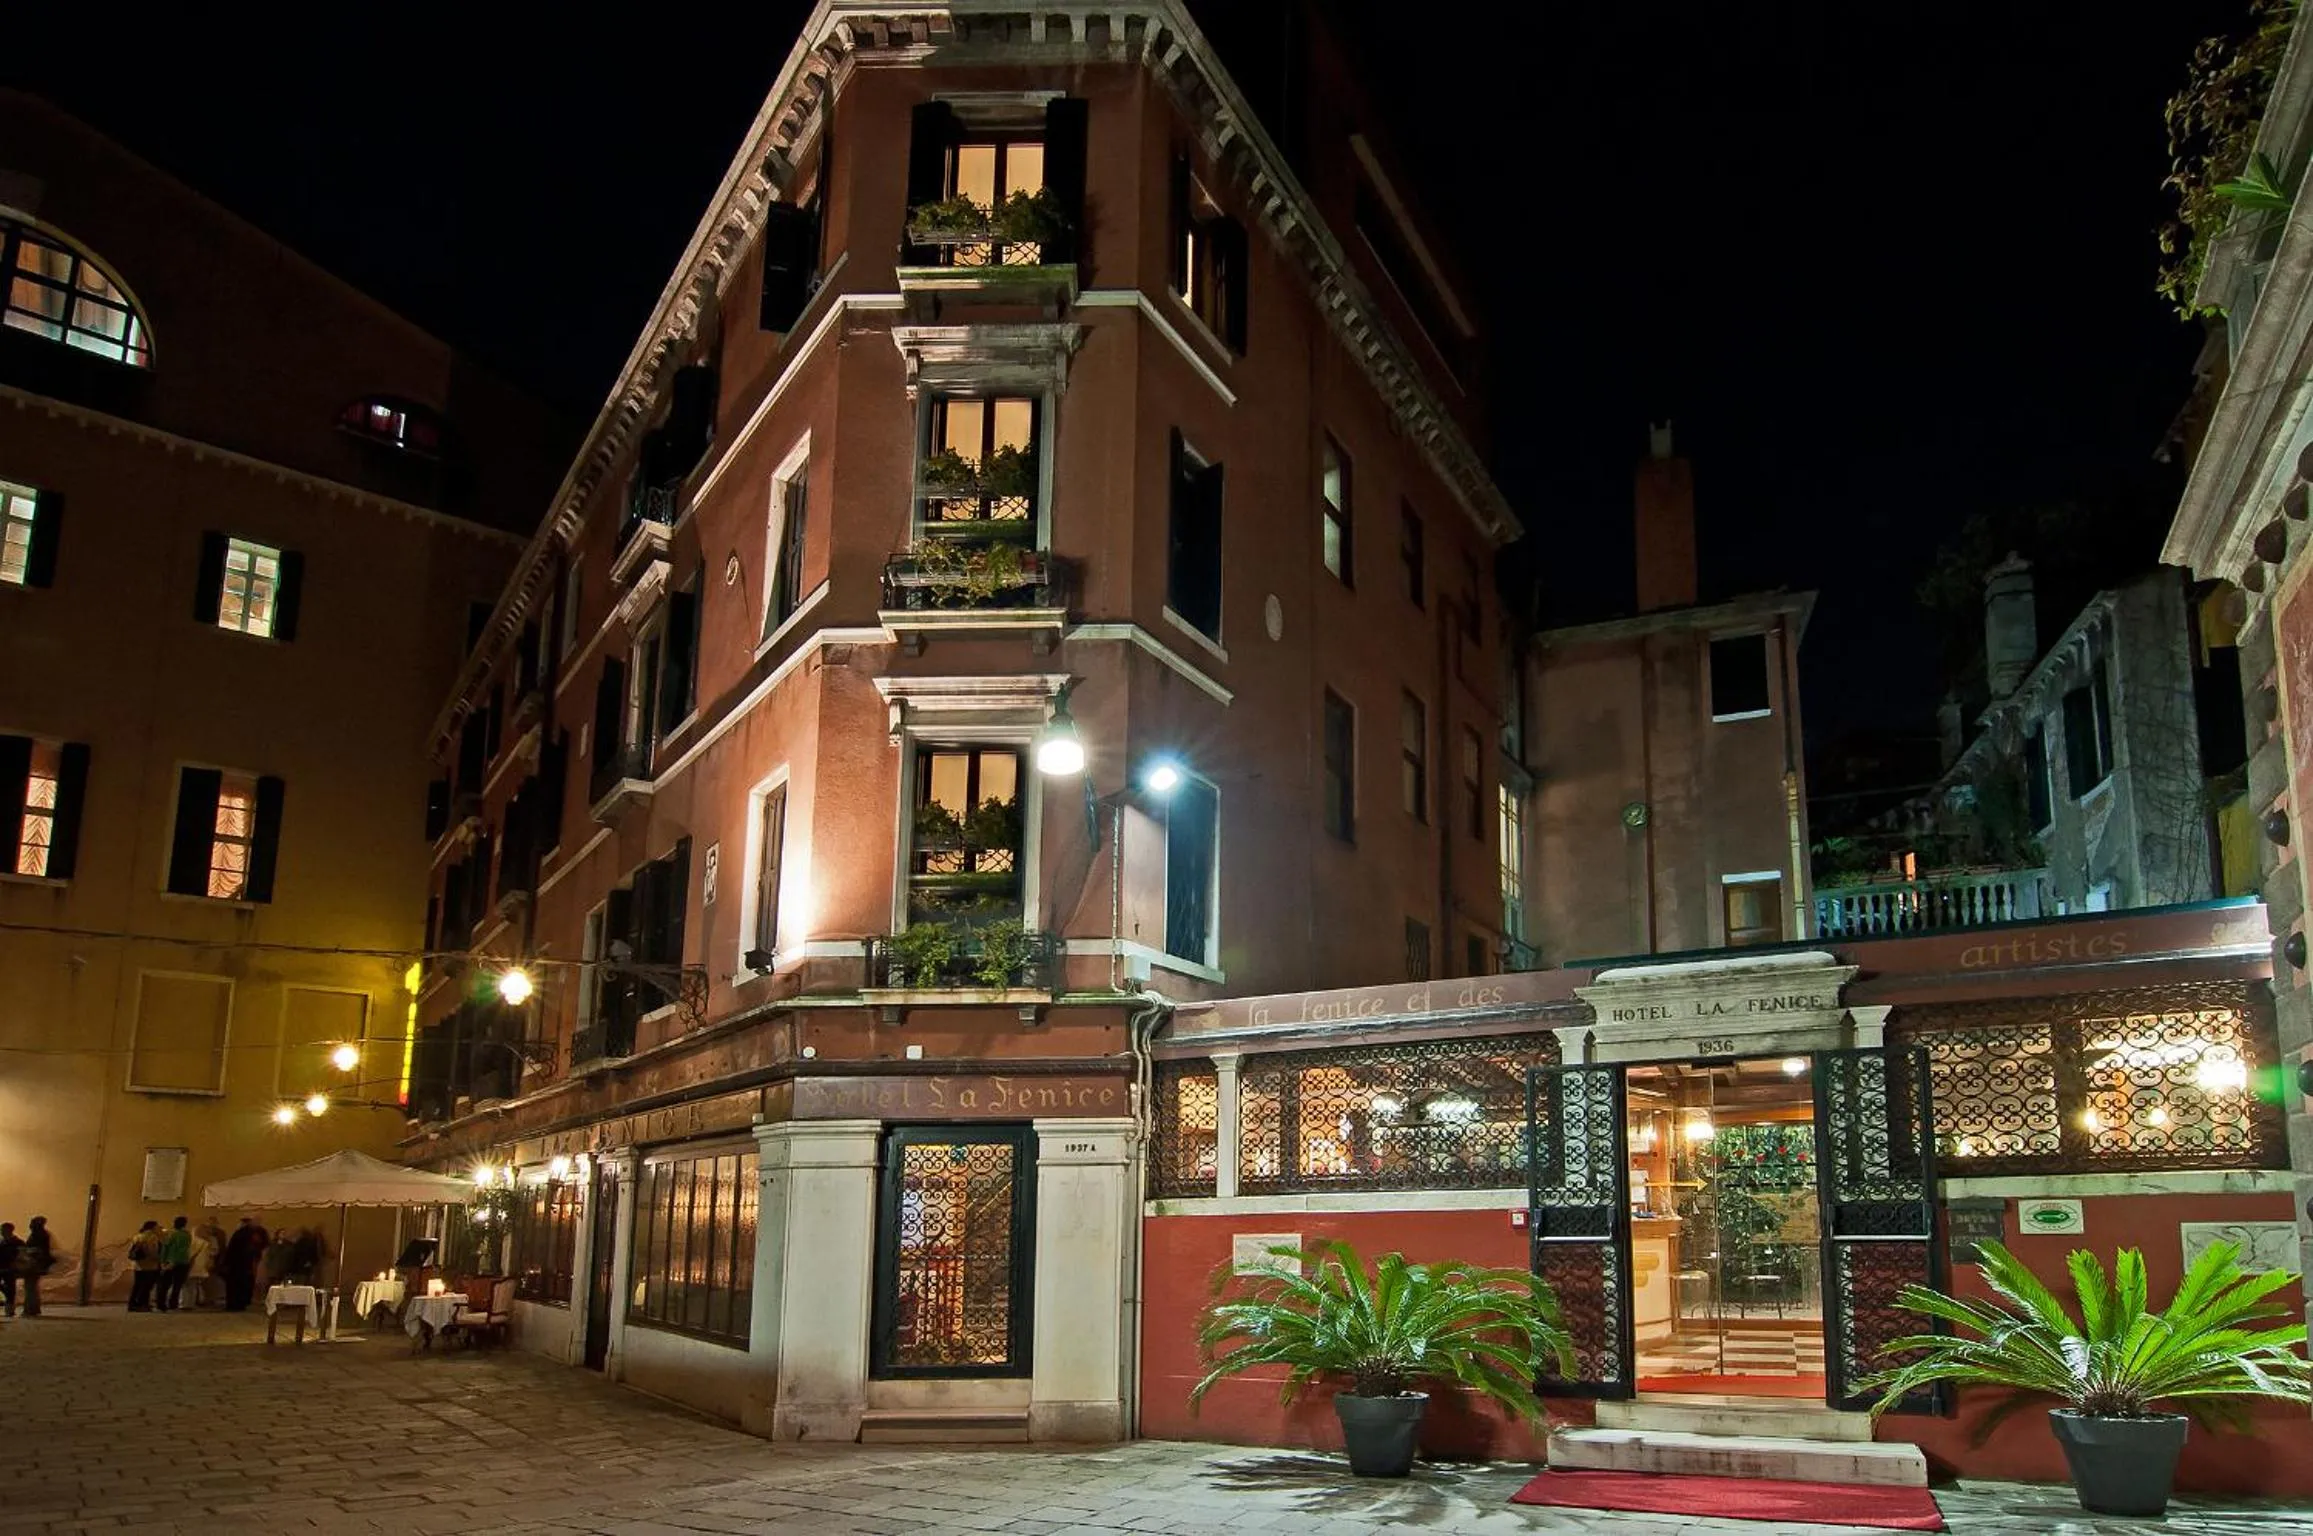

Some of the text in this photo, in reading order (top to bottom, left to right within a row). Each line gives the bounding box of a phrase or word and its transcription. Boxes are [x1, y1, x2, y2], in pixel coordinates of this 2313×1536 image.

[1249, 1000, 1271, 1026] la
[1301, 996, 1385, 1022] fenice
[1458, 981, 1505, 1007] des
[1612, 995, 1823, 1021] HOTEL LA FENICE
[1698, 1040, 1735, 1053] 1936
[927, 1076, 976, 1109] La
[987, 1076, 1115, 1114] Fenice
